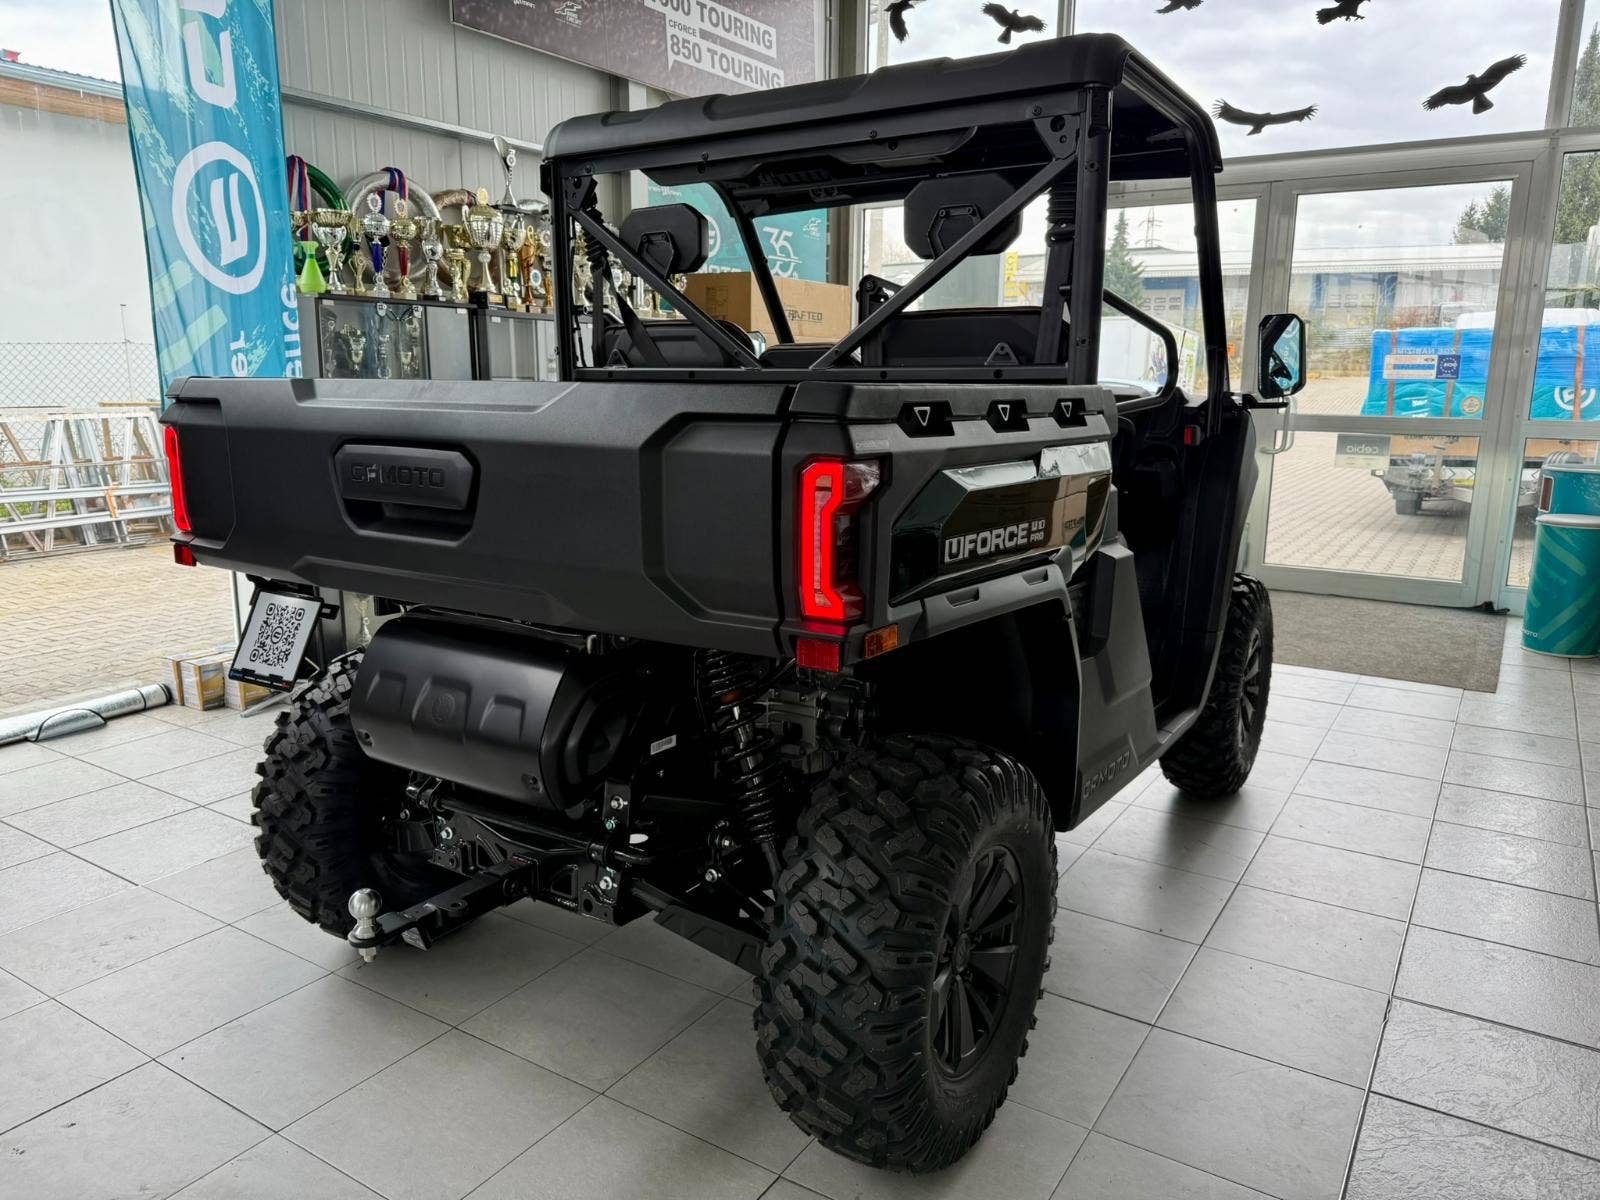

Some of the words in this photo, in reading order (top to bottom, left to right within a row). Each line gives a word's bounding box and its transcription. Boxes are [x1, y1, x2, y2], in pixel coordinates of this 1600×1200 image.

[668, 19, 698, 37] CFORCE
[696, 1, 773, 50] TOURING
[670, 34, 702, 63] 850
[707, 47, 781, 89] TOURING
[944, 523, 1029, 562] UFORCE
